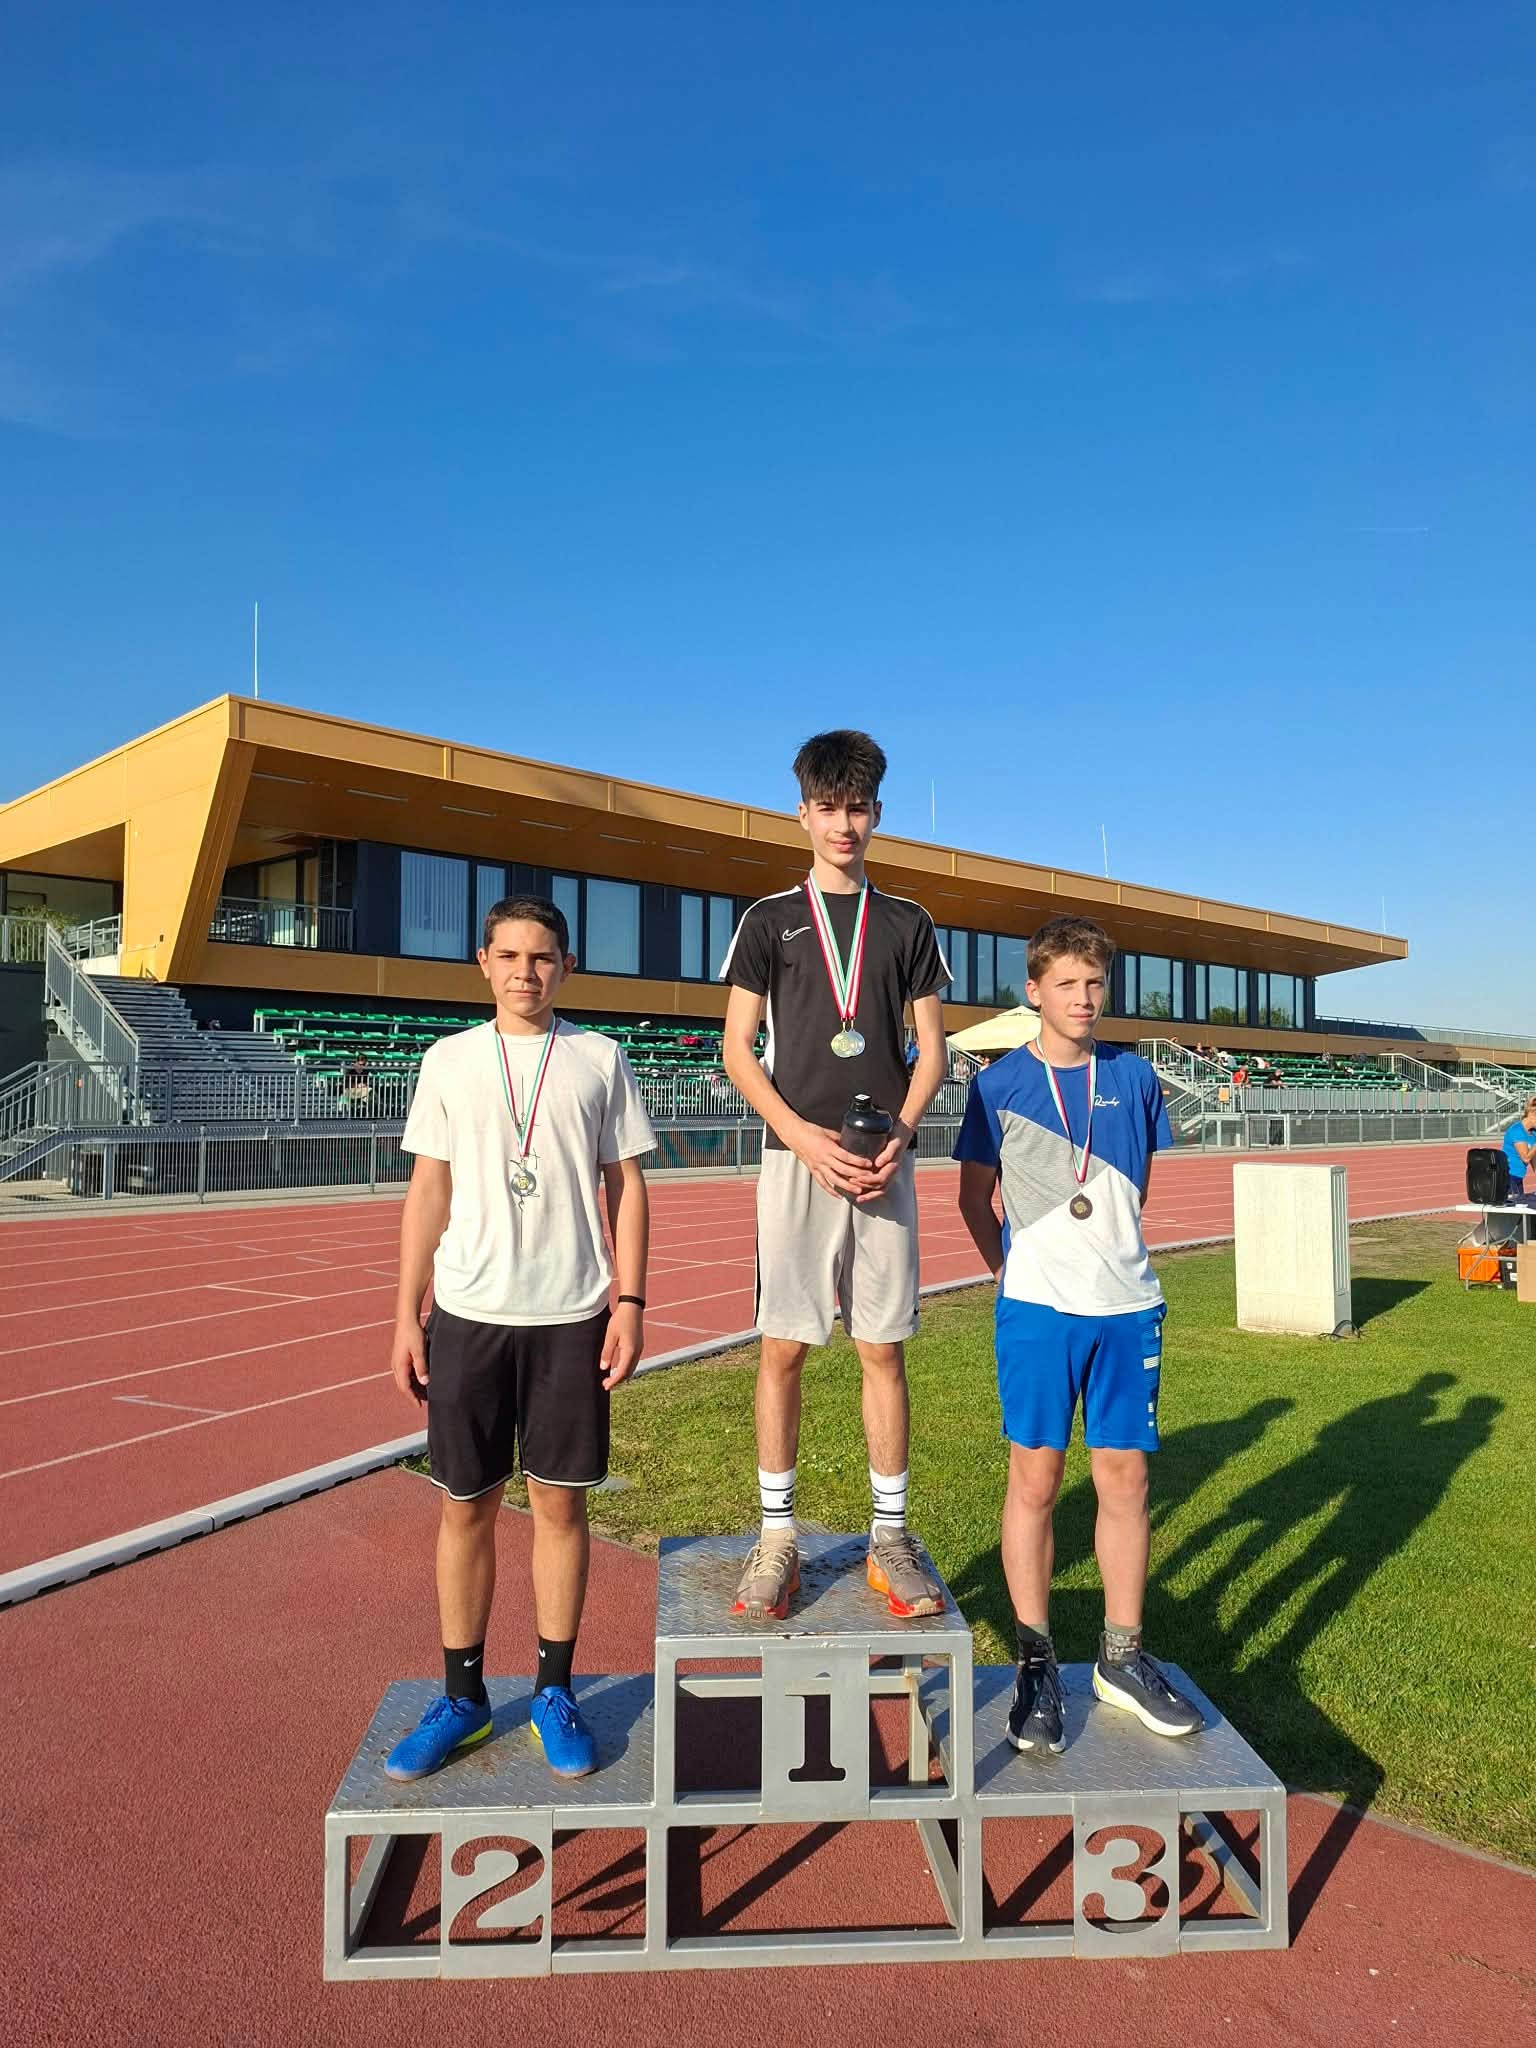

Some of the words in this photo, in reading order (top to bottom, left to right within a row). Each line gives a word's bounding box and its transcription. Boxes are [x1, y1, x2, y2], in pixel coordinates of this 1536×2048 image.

[785, 1671, 846, 1782] 1
[448, 1835, 545, 1946] 2
[1081, 1825, 1169, 1934] 3
